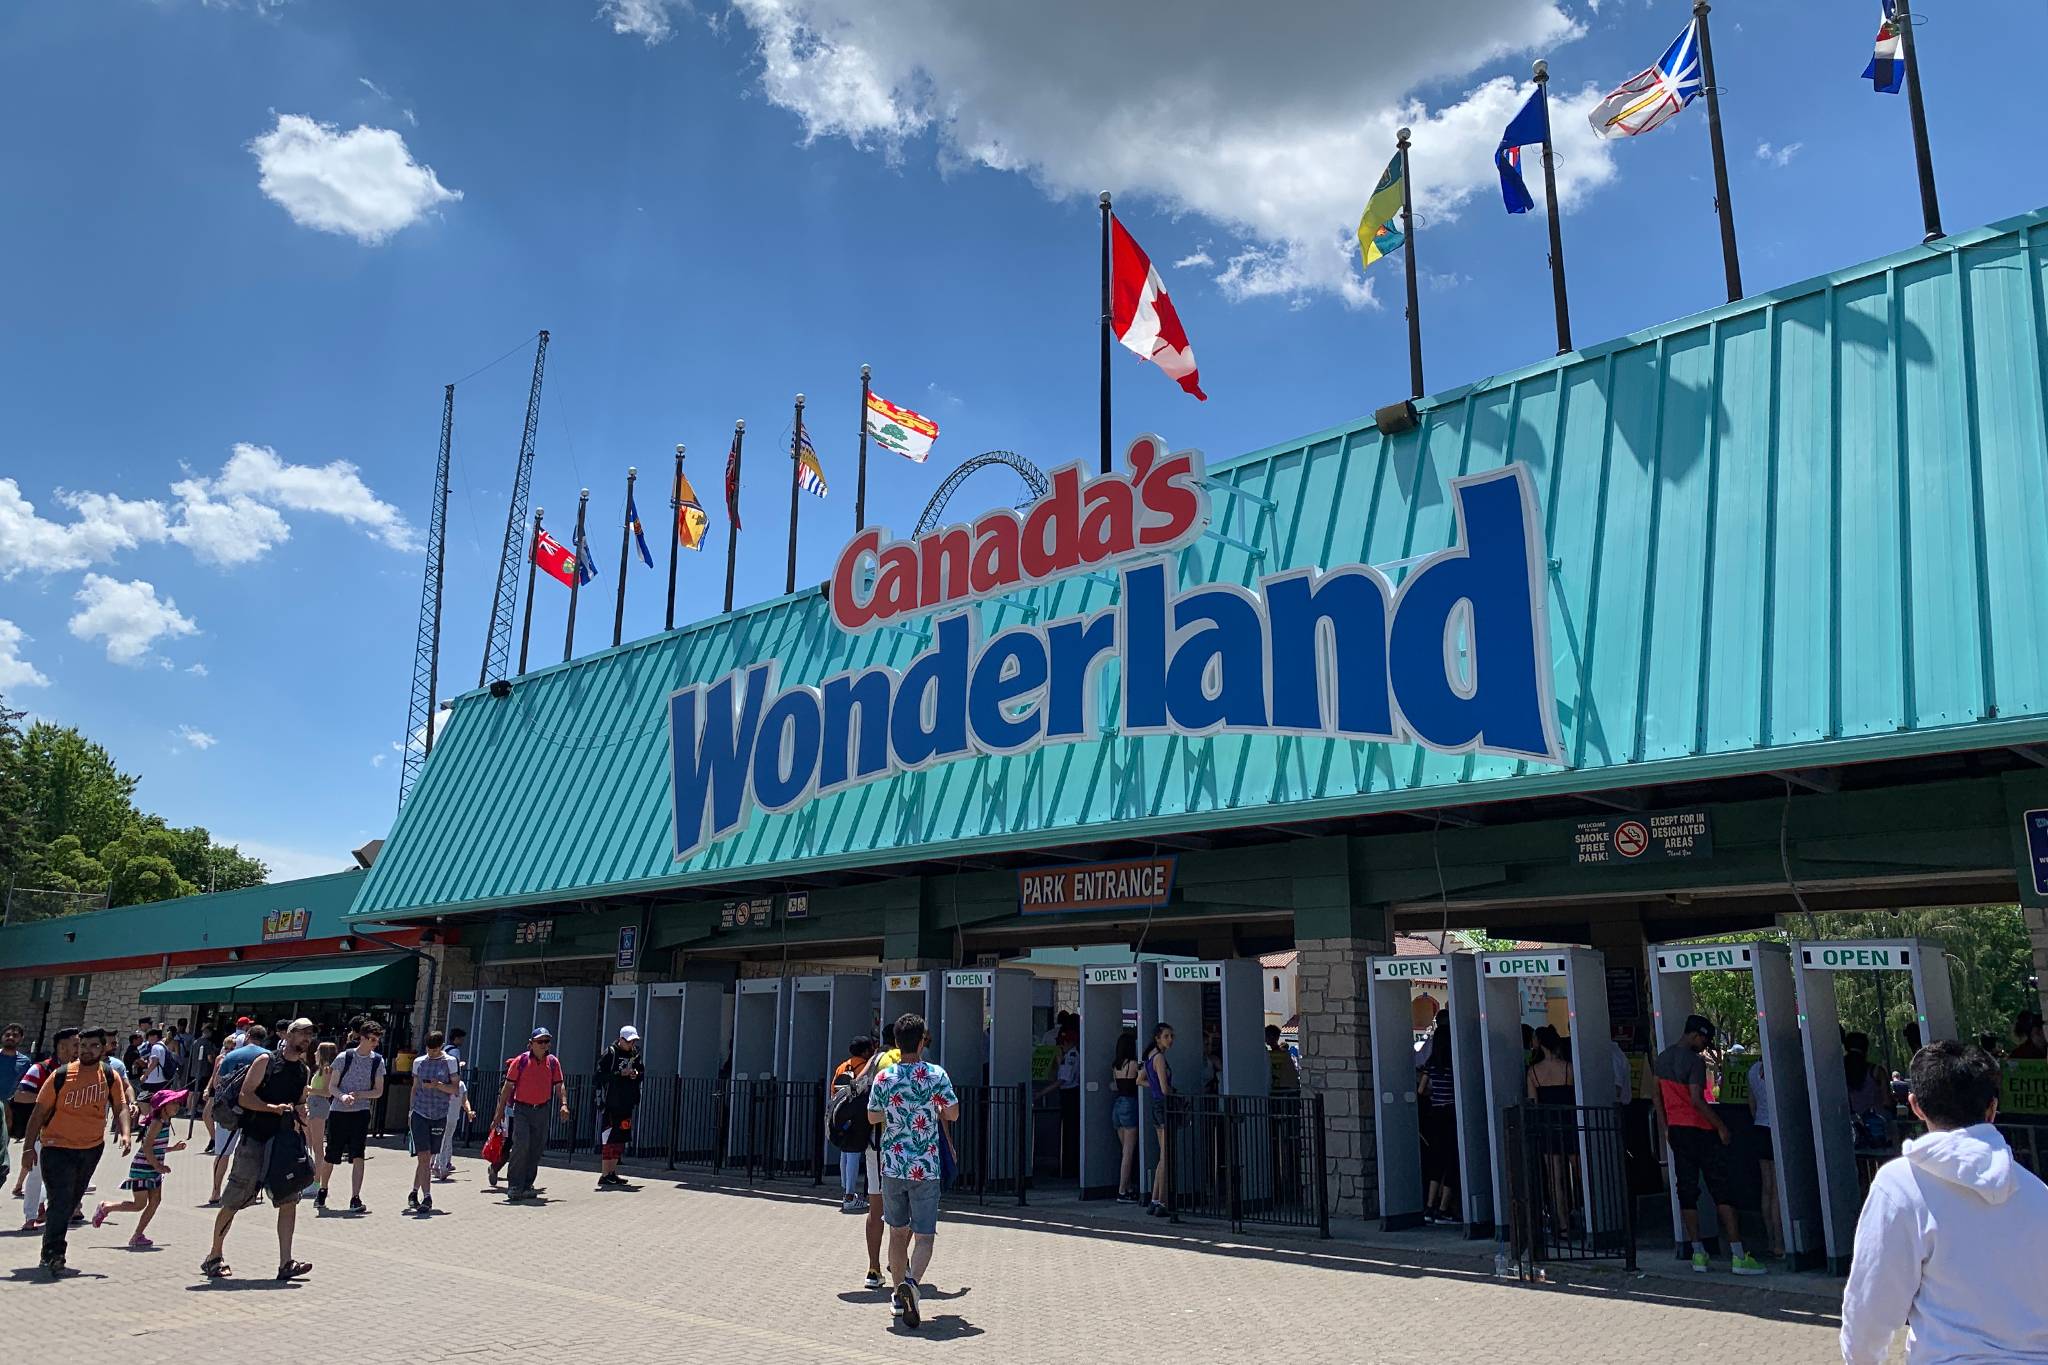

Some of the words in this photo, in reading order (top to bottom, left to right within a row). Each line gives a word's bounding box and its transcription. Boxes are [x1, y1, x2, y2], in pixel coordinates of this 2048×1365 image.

[832, 437, 1202, 630] Canada's
[669, 468, 1552, 856] Wonderland
[1577, 821, 1606, 830] WELCOME
[1650, 815, 1678, 827] EXCEPT
[1680, 813, 1695, 824] FOR
[1696, 813, 1705, 823] IN
[1652, 824, 1705, 838] DESIGNATED
[1575, 832, 1610, 844] SMOKE
[1664, 836, 1694, 849] AREAS
[1580, 842, 1606, 853] FREE
[1578, 852, 1609, 863] PARK!
[1023, 874, 1066, 905] PARK
[1074, 865, 1165, 901] ENTRANCE
[1676, 950, 1734, 968] OPEN
[1823, 950, 1890, 966] OPEN
[1174, 966, 1209, 979] OPEN
[1388, 962, 1433, 976] OPEN
[1499, 959, 1550, 973] OPEN
[955, 974, 983, 986] OPEN
[1094, 969, 1127, 982] OPEN
[540, 991, 562, 1001] CLOSED
